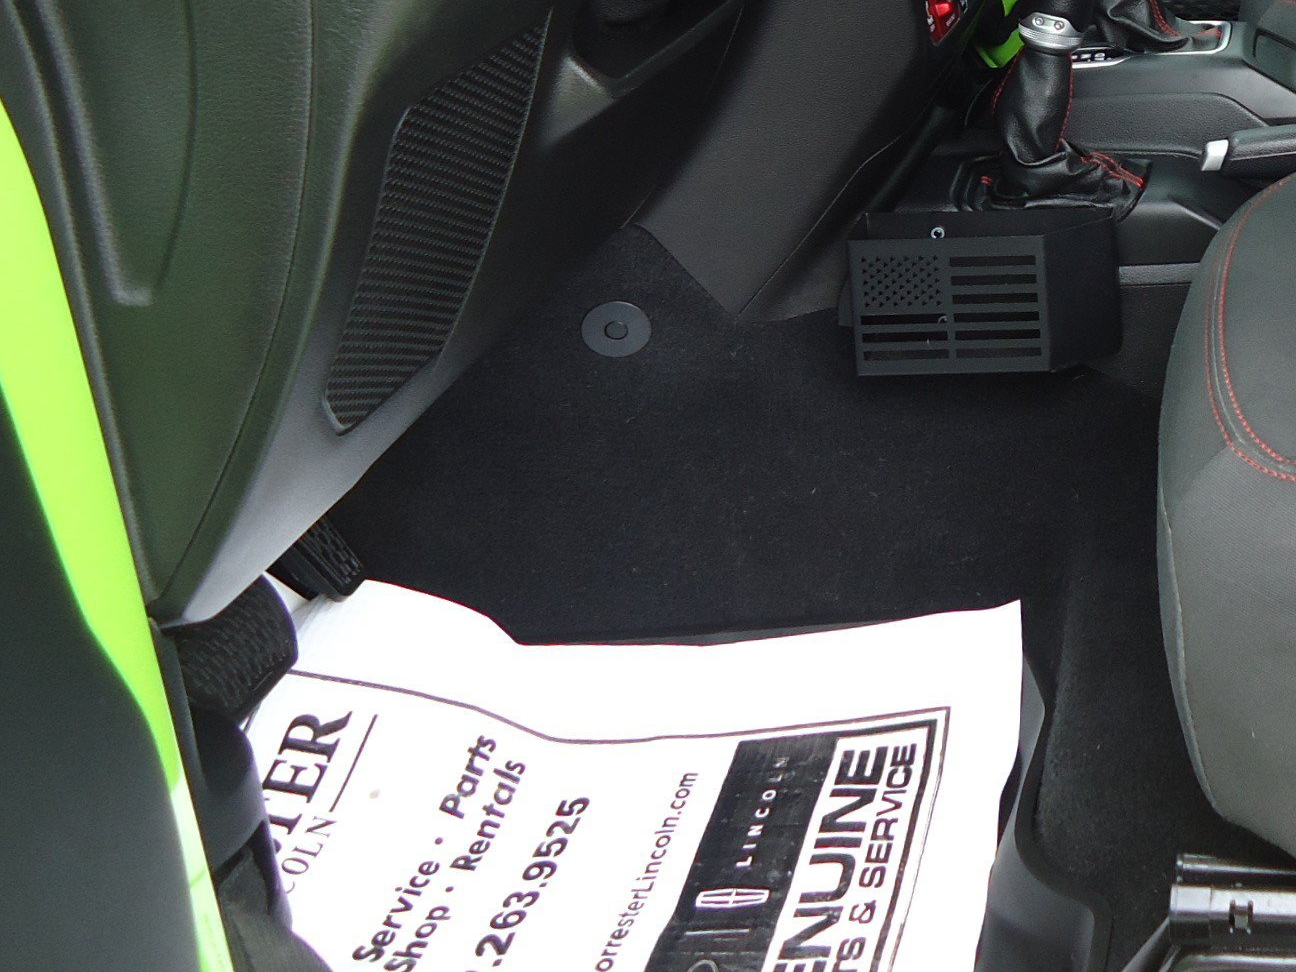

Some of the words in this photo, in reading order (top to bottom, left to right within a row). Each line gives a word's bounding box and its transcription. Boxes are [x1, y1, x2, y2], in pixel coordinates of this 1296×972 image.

[262, 710, 353, 855] TER
[352, 860, 440, 963] Service
[439, 734, 496, 820] Parts
[858, 743, 918, 888] SERVICE
[383, 905, 451, 972] Shop
[450, 760, 526, 871] Rentals
[465, 796, 590, 972] .263.9525
[848, 899, 877, 924] &
